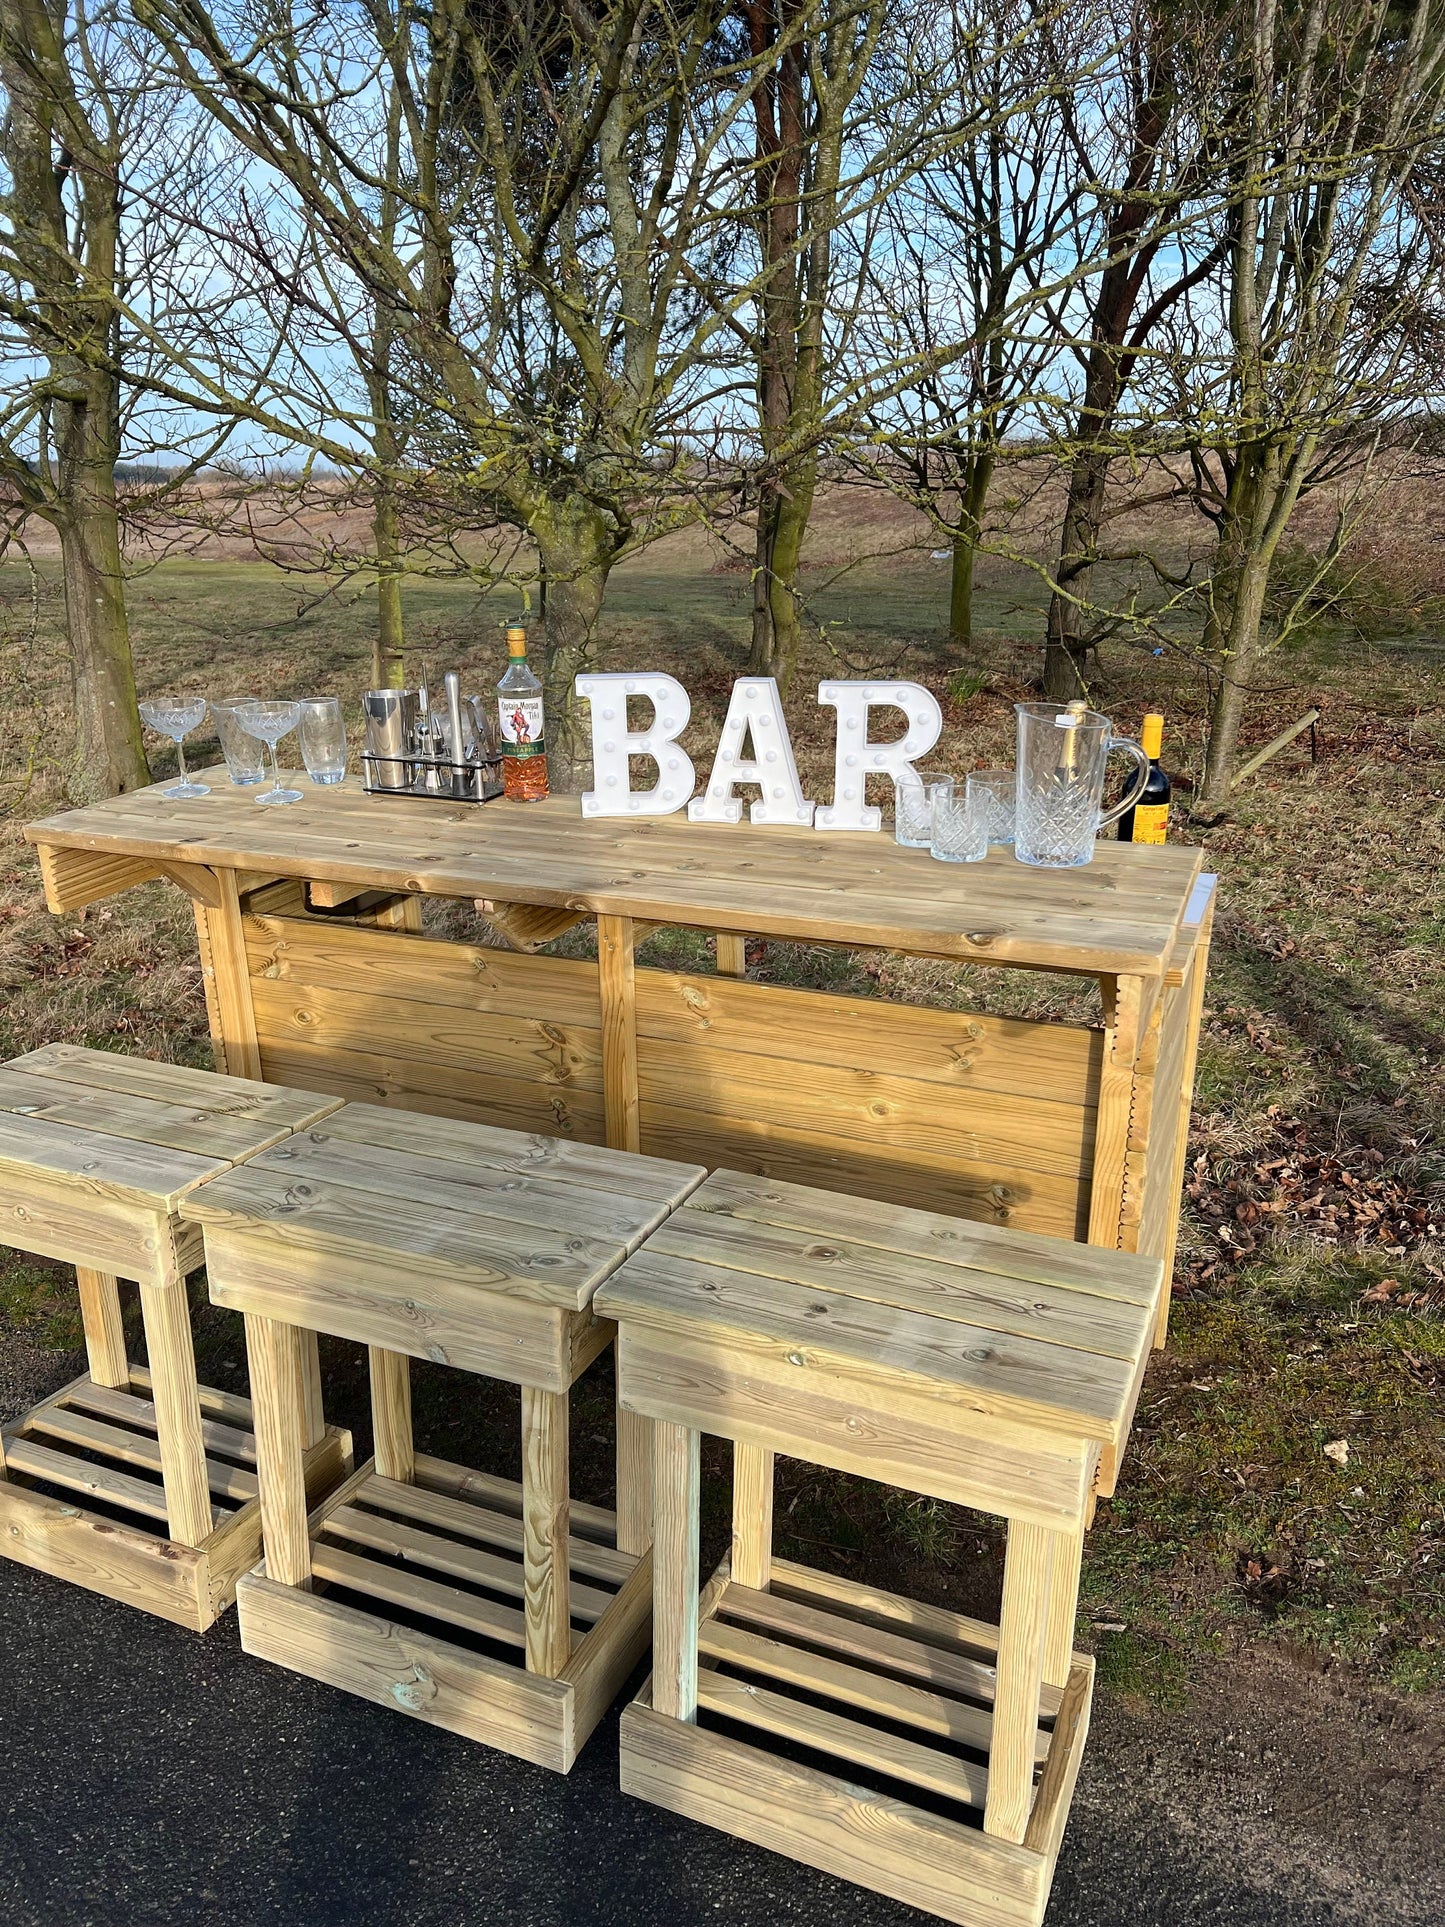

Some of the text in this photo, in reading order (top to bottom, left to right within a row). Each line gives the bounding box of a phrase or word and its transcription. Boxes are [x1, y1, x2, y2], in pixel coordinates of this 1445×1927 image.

[501, 702, 538, 711] Captain Morgan
[575, 672, 942, 831] BAR
